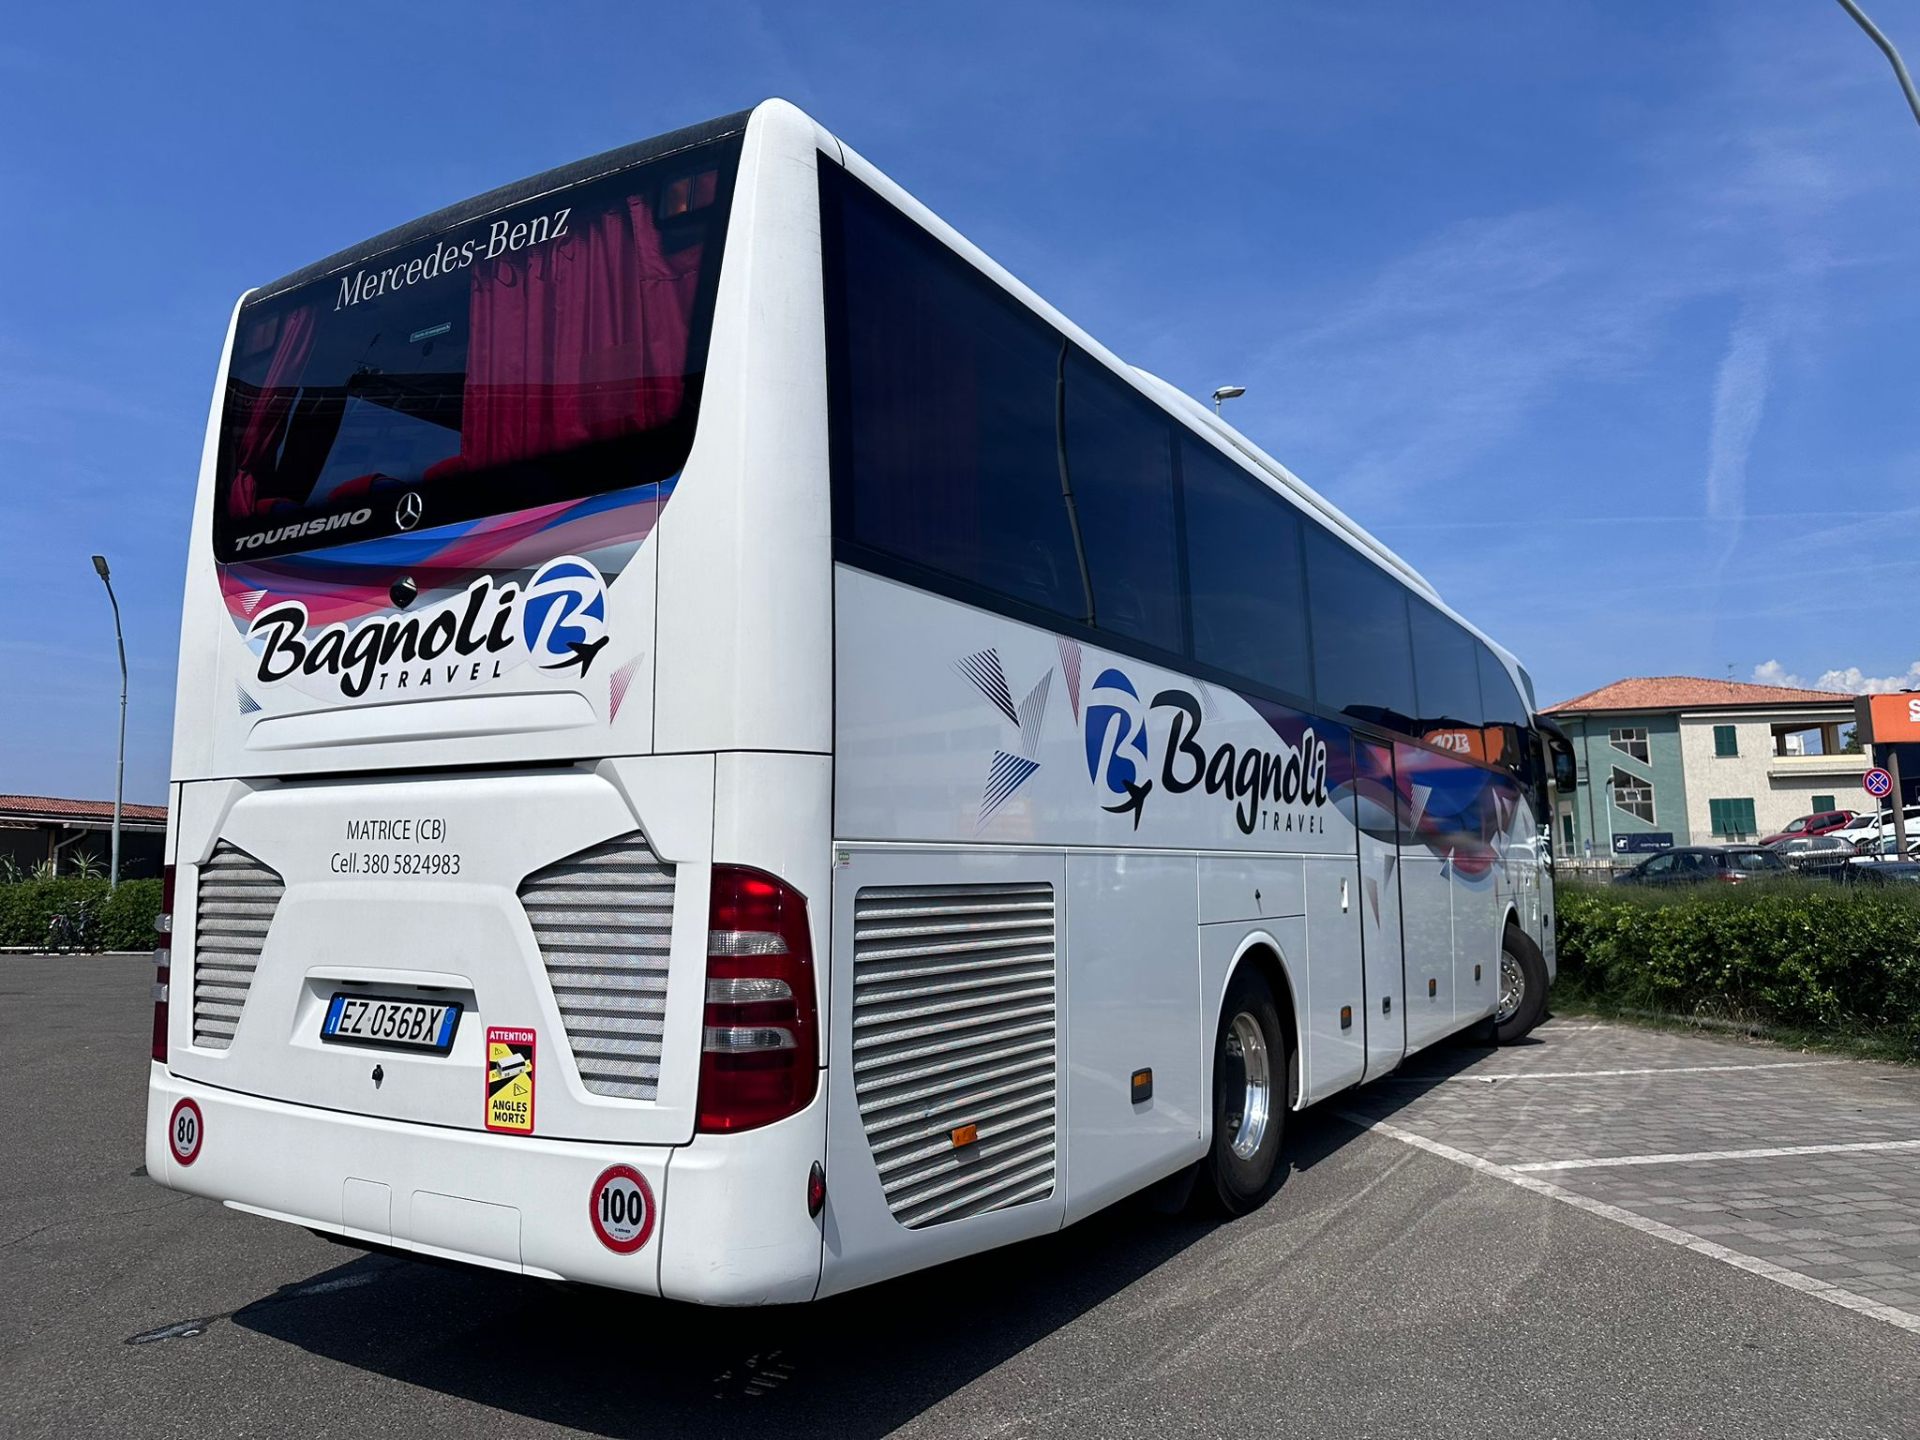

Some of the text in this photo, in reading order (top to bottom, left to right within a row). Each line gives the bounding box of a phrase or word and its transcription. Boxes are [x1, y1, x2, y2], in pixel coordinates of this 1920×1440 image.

[333, 207, 572, 312] Mercedes-Benz
[234, 507, 373, 552] TOURISMO
[250, 582, 517, 698] Bagnoli
[379, 659, 503, 690] TRAVEL
[1149, 689, 1327, 835] Bagnoli
[346, 818, 446, 844] MATRICE (CB)
[1261, 809, 1325, 834] TRAVEL
[330, 852, 461, 875] Cell. 380 5824983
[489, 1030, 534, 1042] ATTENTION
[492, 1099, 528, 1113] ANGLES
[493, 1111, 526, 1125] MORTS
[177, 1116, 195, 1145] 80
[601, 1187, 643, 1226] 100
